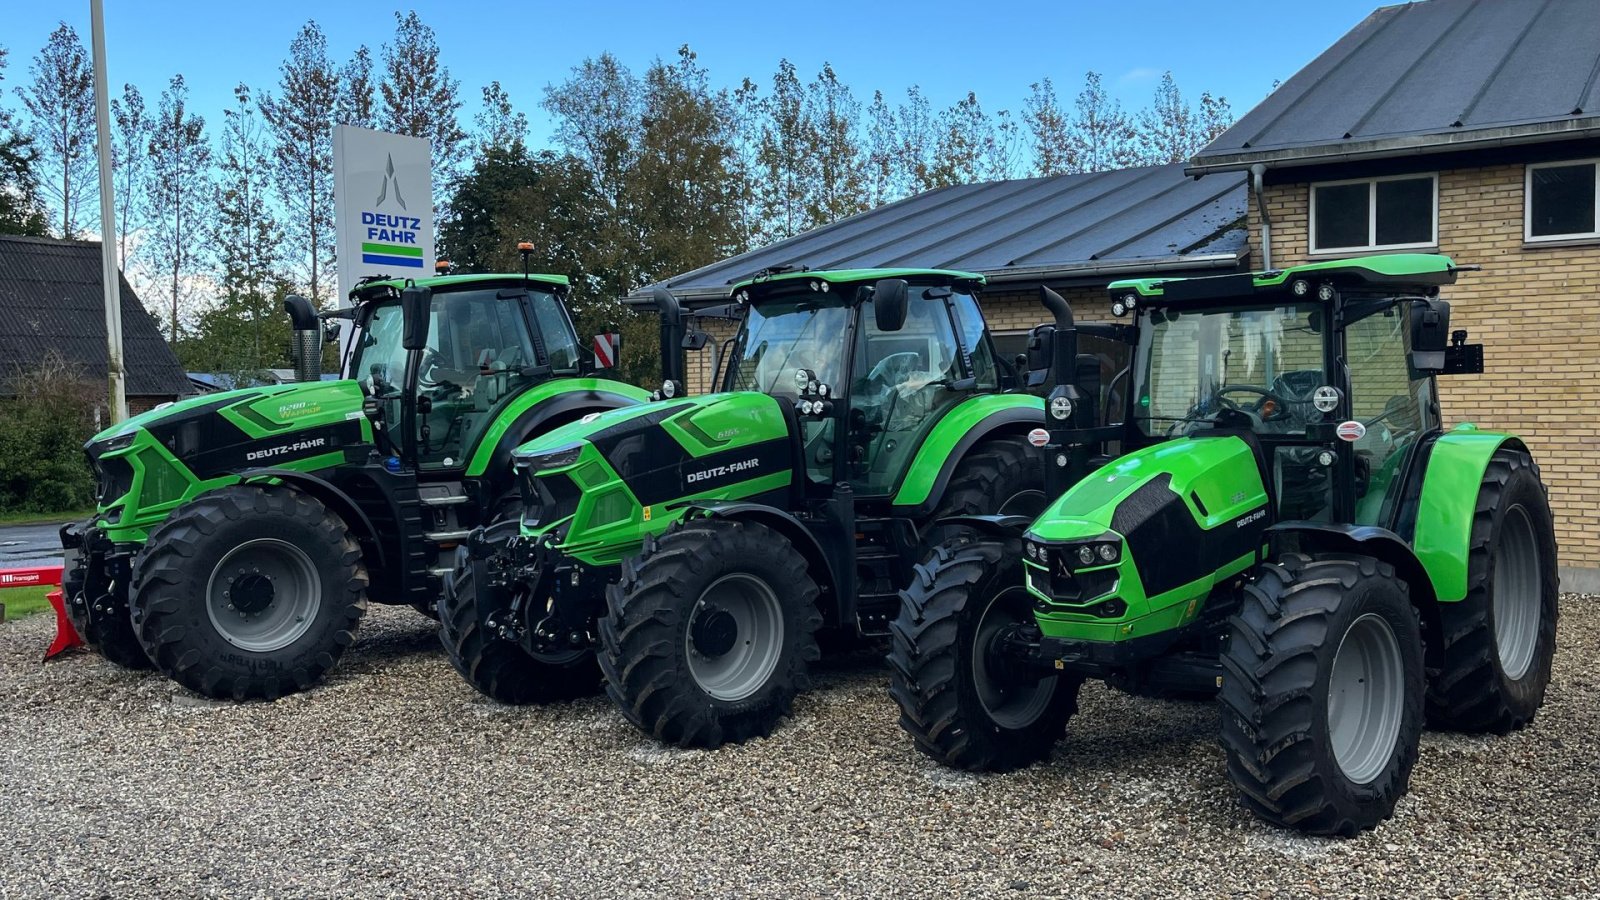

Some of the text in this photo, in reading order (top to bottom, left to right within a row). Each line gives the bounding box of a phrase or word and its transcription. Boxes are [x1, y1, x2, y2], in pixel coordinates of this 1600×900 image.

[362, 212, 421, 230] DEUTZ
[368, 227, 416, 244] FAHR
[246, 438, 325, 460] DEUTZ-FAHR
[687, 458, 759, 483] DEUTZ-FAHR
[1236, 509, 1266, 528] DEUTZ-FAHR
